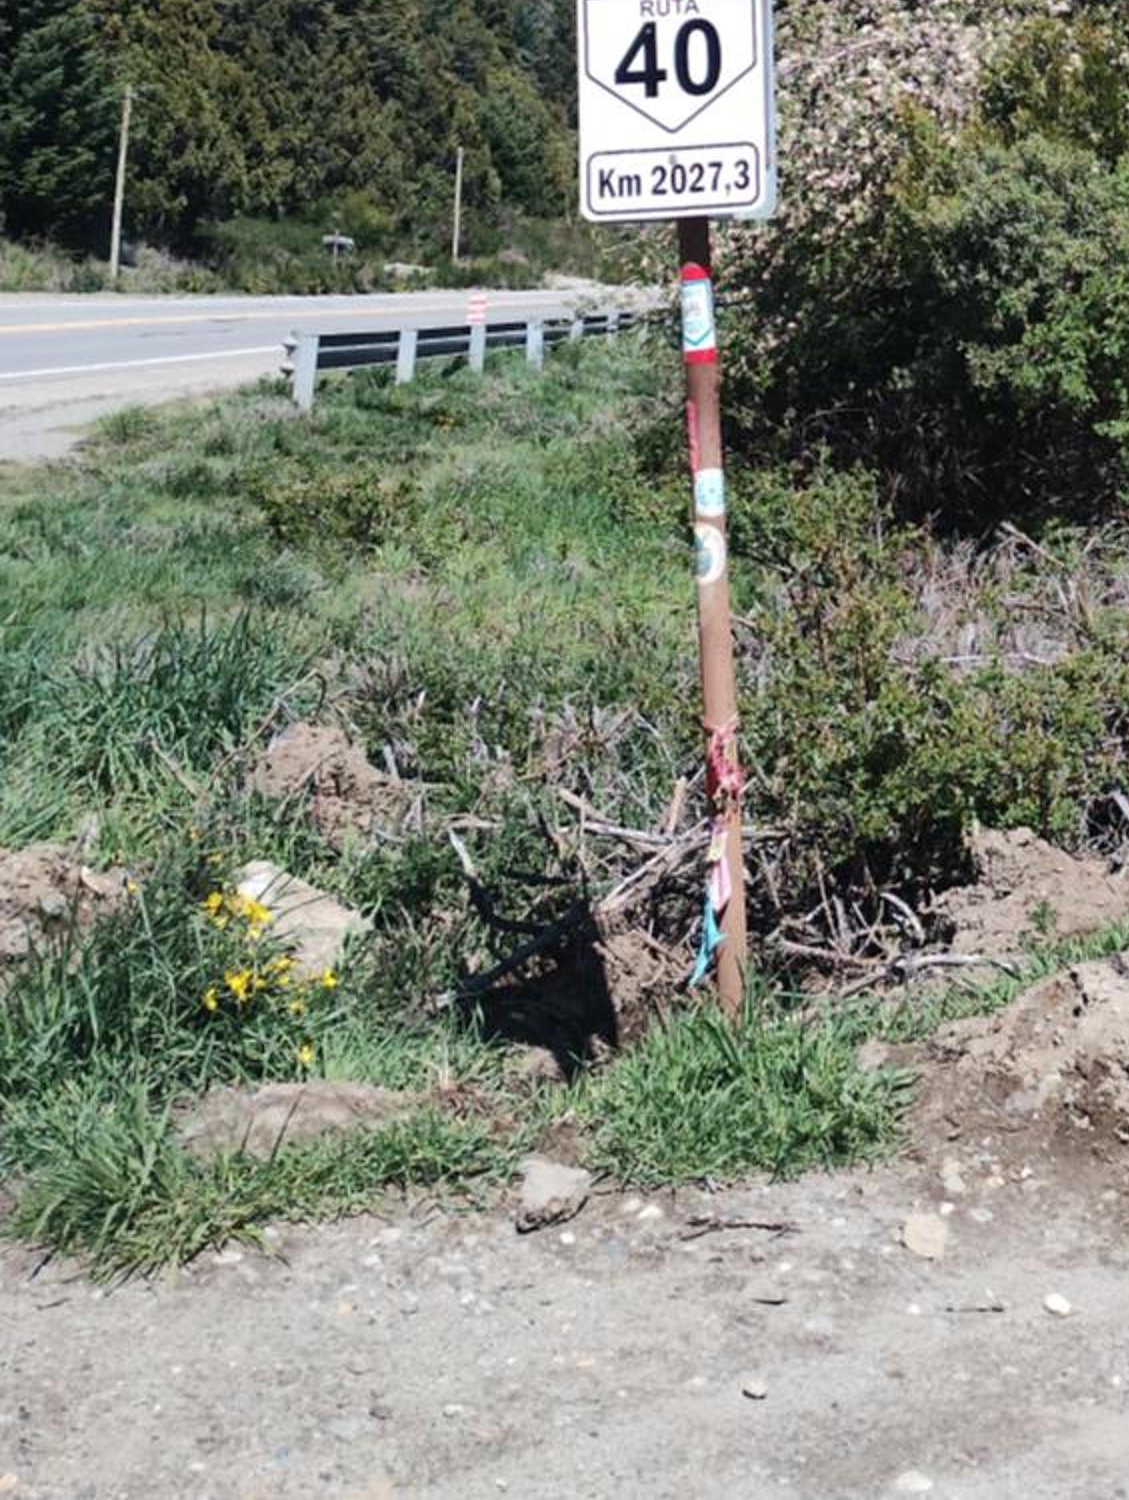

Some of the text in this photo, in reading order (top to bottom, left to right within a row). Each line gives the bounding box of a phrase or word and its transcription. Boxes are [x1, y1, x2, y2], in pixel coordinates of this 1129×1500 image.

[614, 18, 722, 98] 40
[599, 159, 750, 198] Km 2027,3
